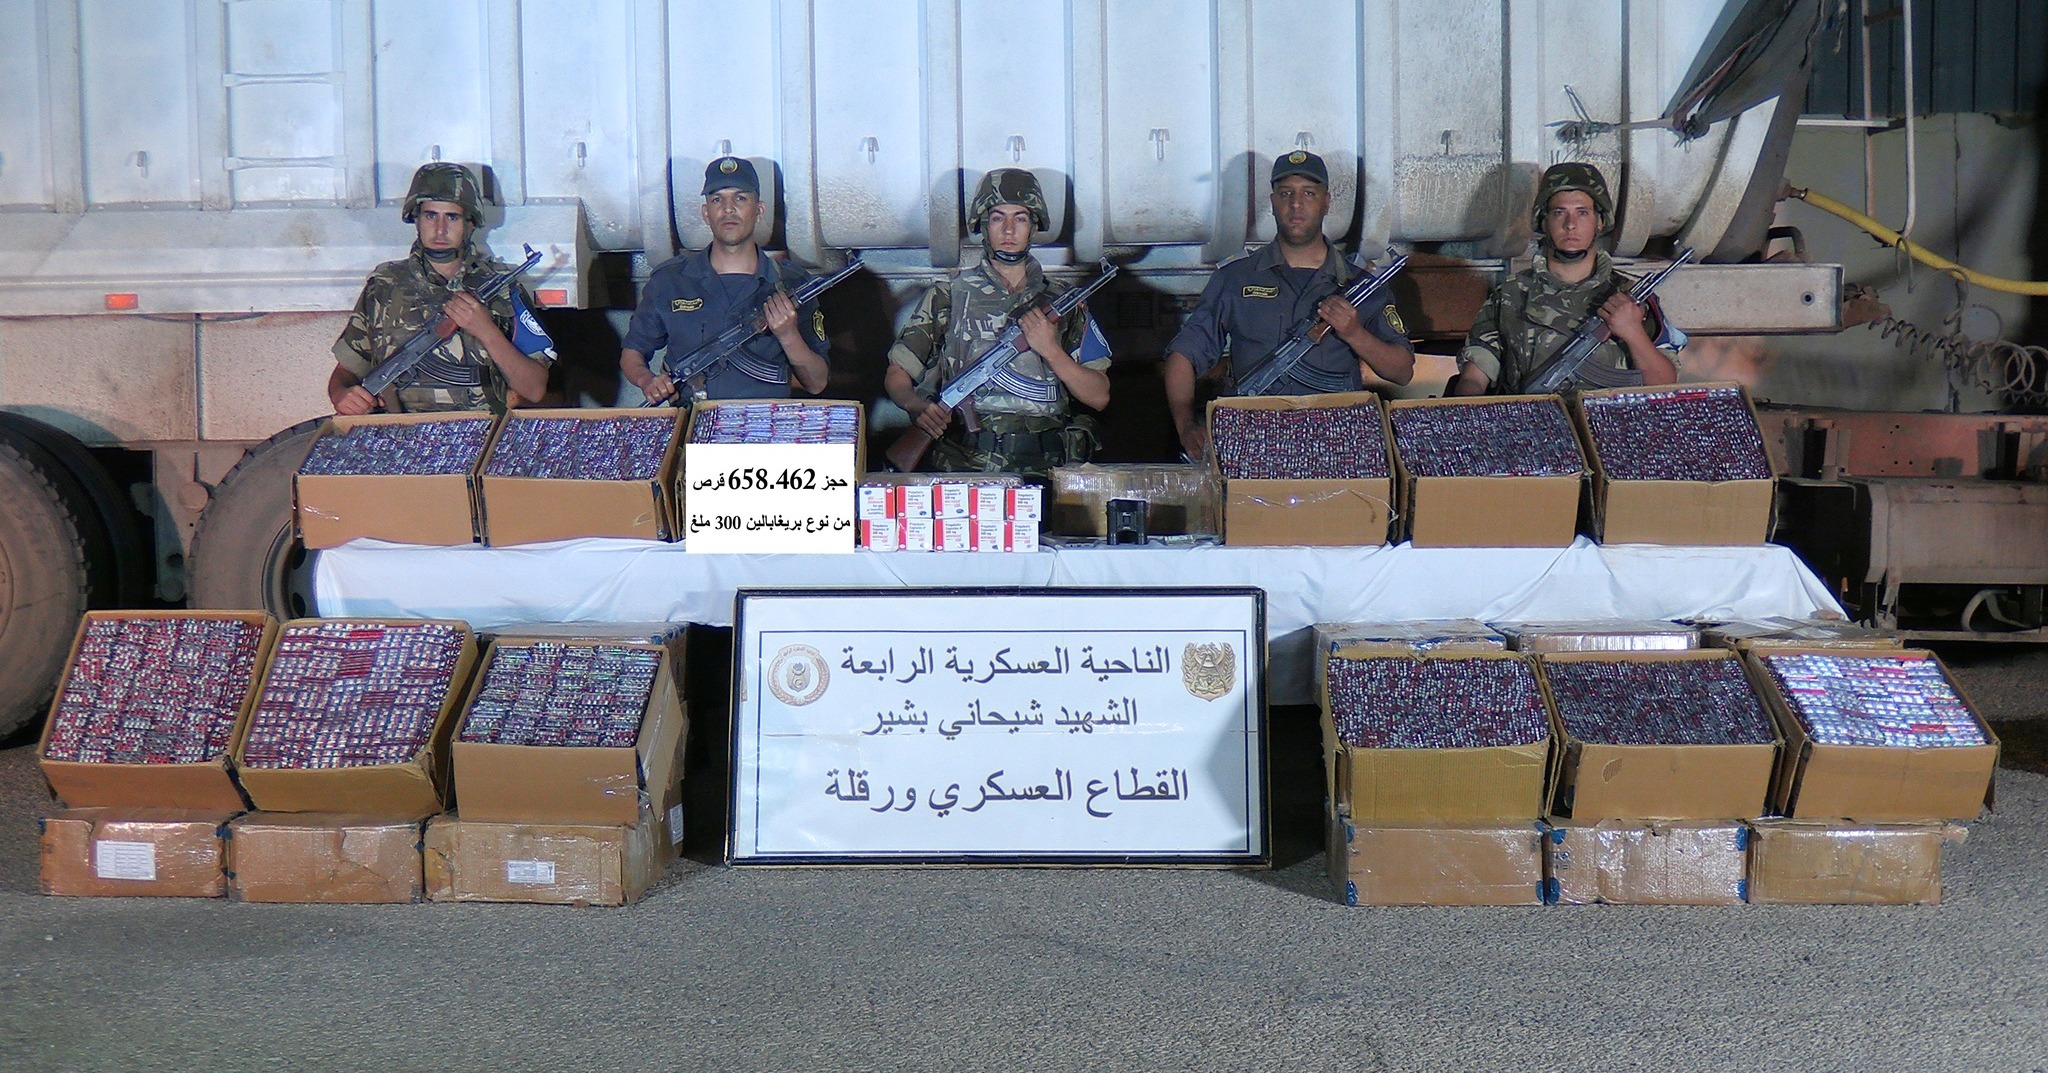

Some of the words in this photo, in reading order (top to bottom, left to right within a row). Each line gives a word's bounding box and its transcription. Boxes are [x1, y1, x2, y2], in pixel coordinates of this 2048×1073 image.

[840, 646, 934, 684] الرابعة
[944, 646, 1070, 684] العسكرية
[1080, 646, 1170, 683] الناحية
[862, 699, 928, 736] بشير
[938, 698, 1044, 741] شيحاني
[1055, 697, 1138, 735] الشهيد
[825, 768, 917, 813] ورقلة
[928, 767, 1072, 818] العسكري
[1086, 768, 1189, 818] القطاع
